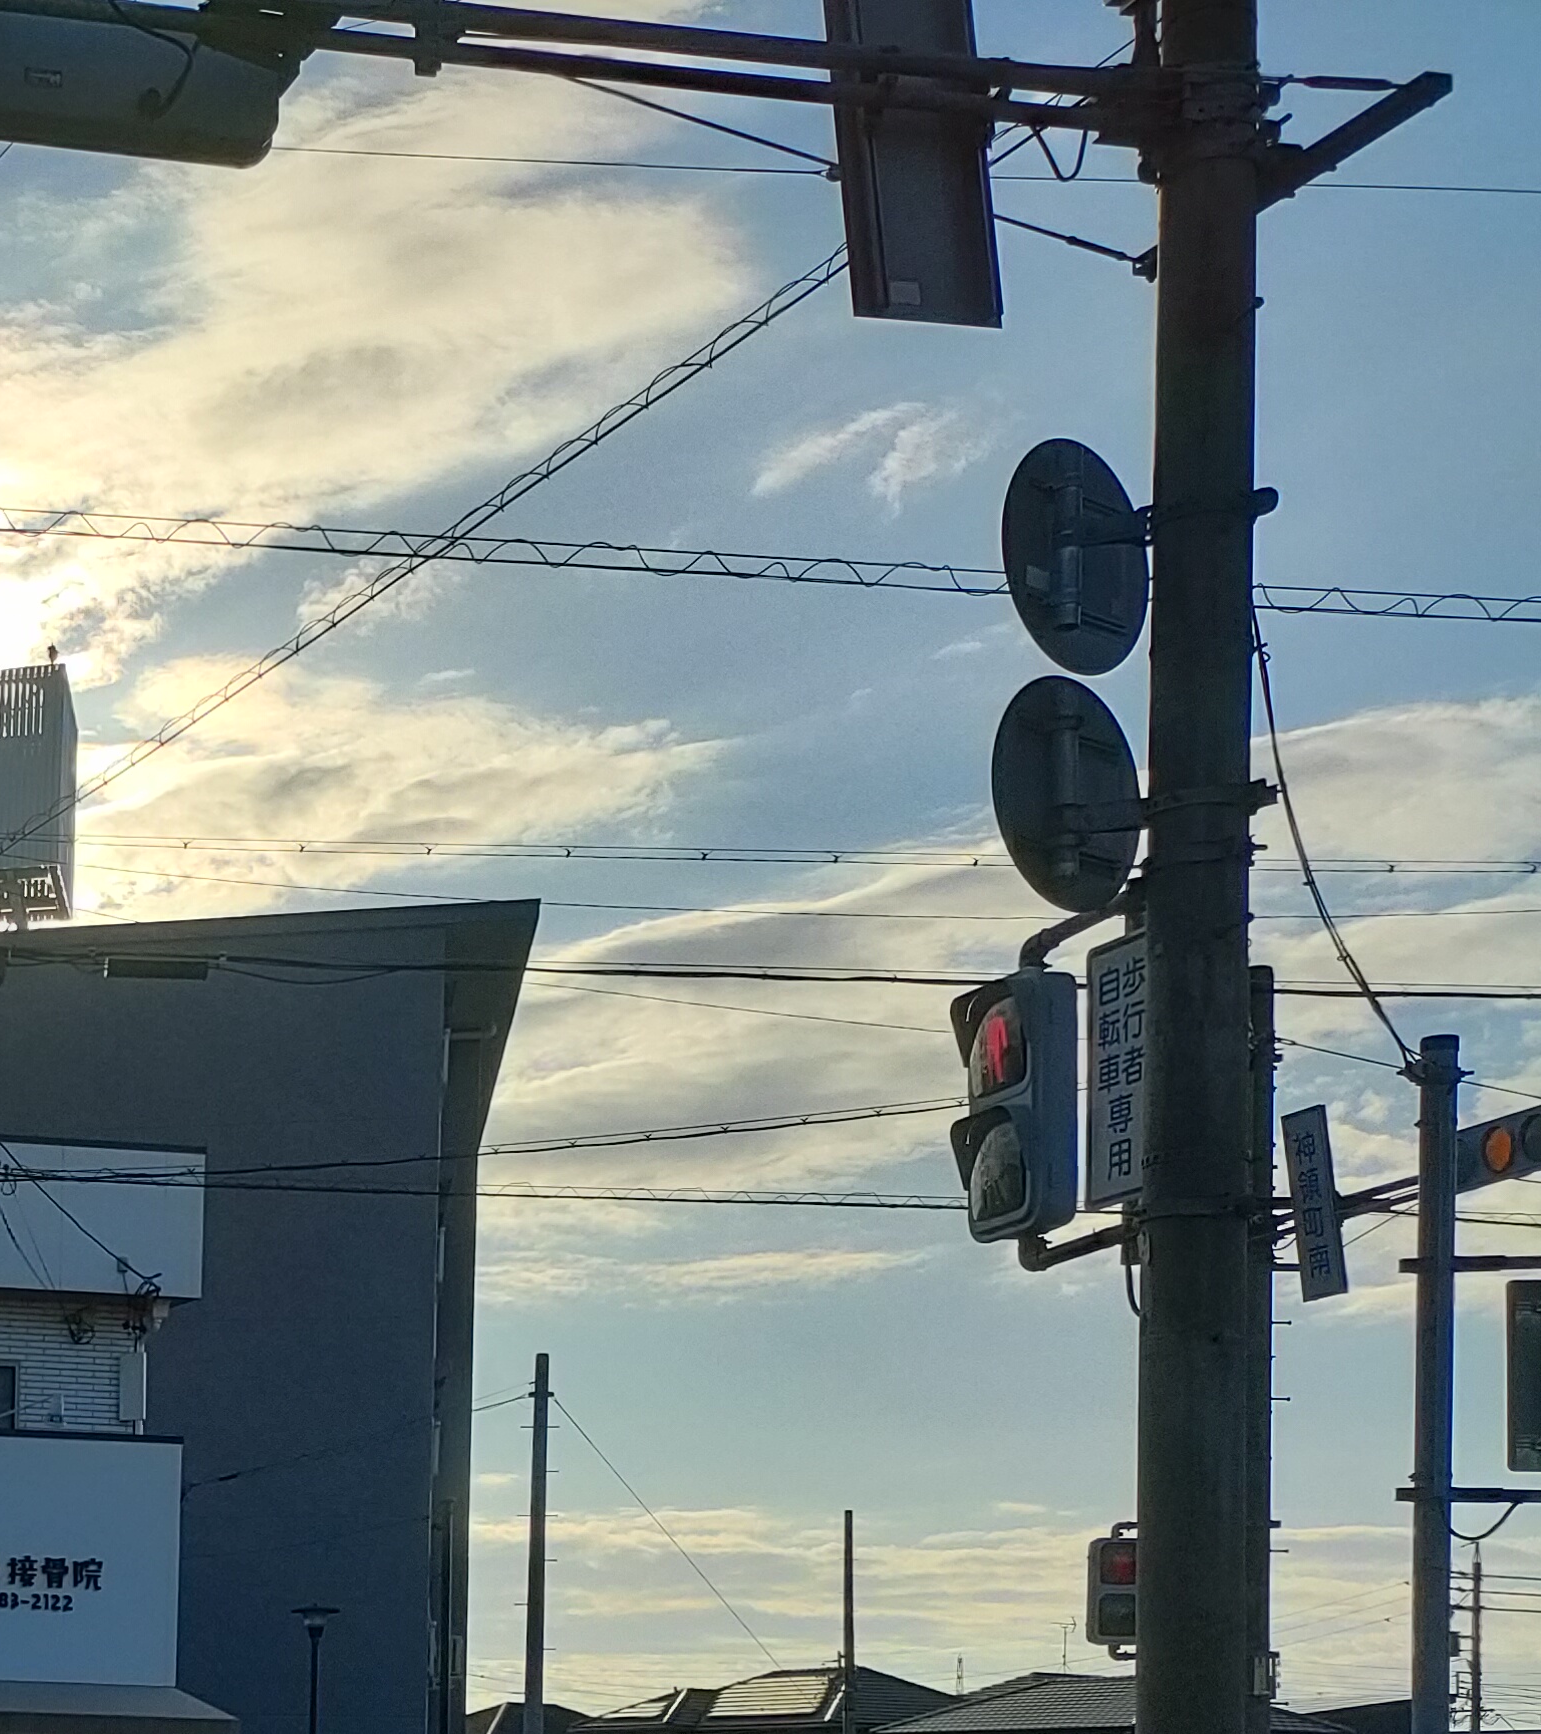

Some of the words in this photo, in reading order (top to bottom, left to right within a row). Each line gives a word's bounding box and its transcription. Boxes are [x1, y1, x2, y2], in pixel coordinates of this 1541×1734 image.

[1097, 966, 1121, 1094] 自転車
[1122, 956, 1146, 1087] 歩行者
[1107, 1092, 1134, 1181] 専用
